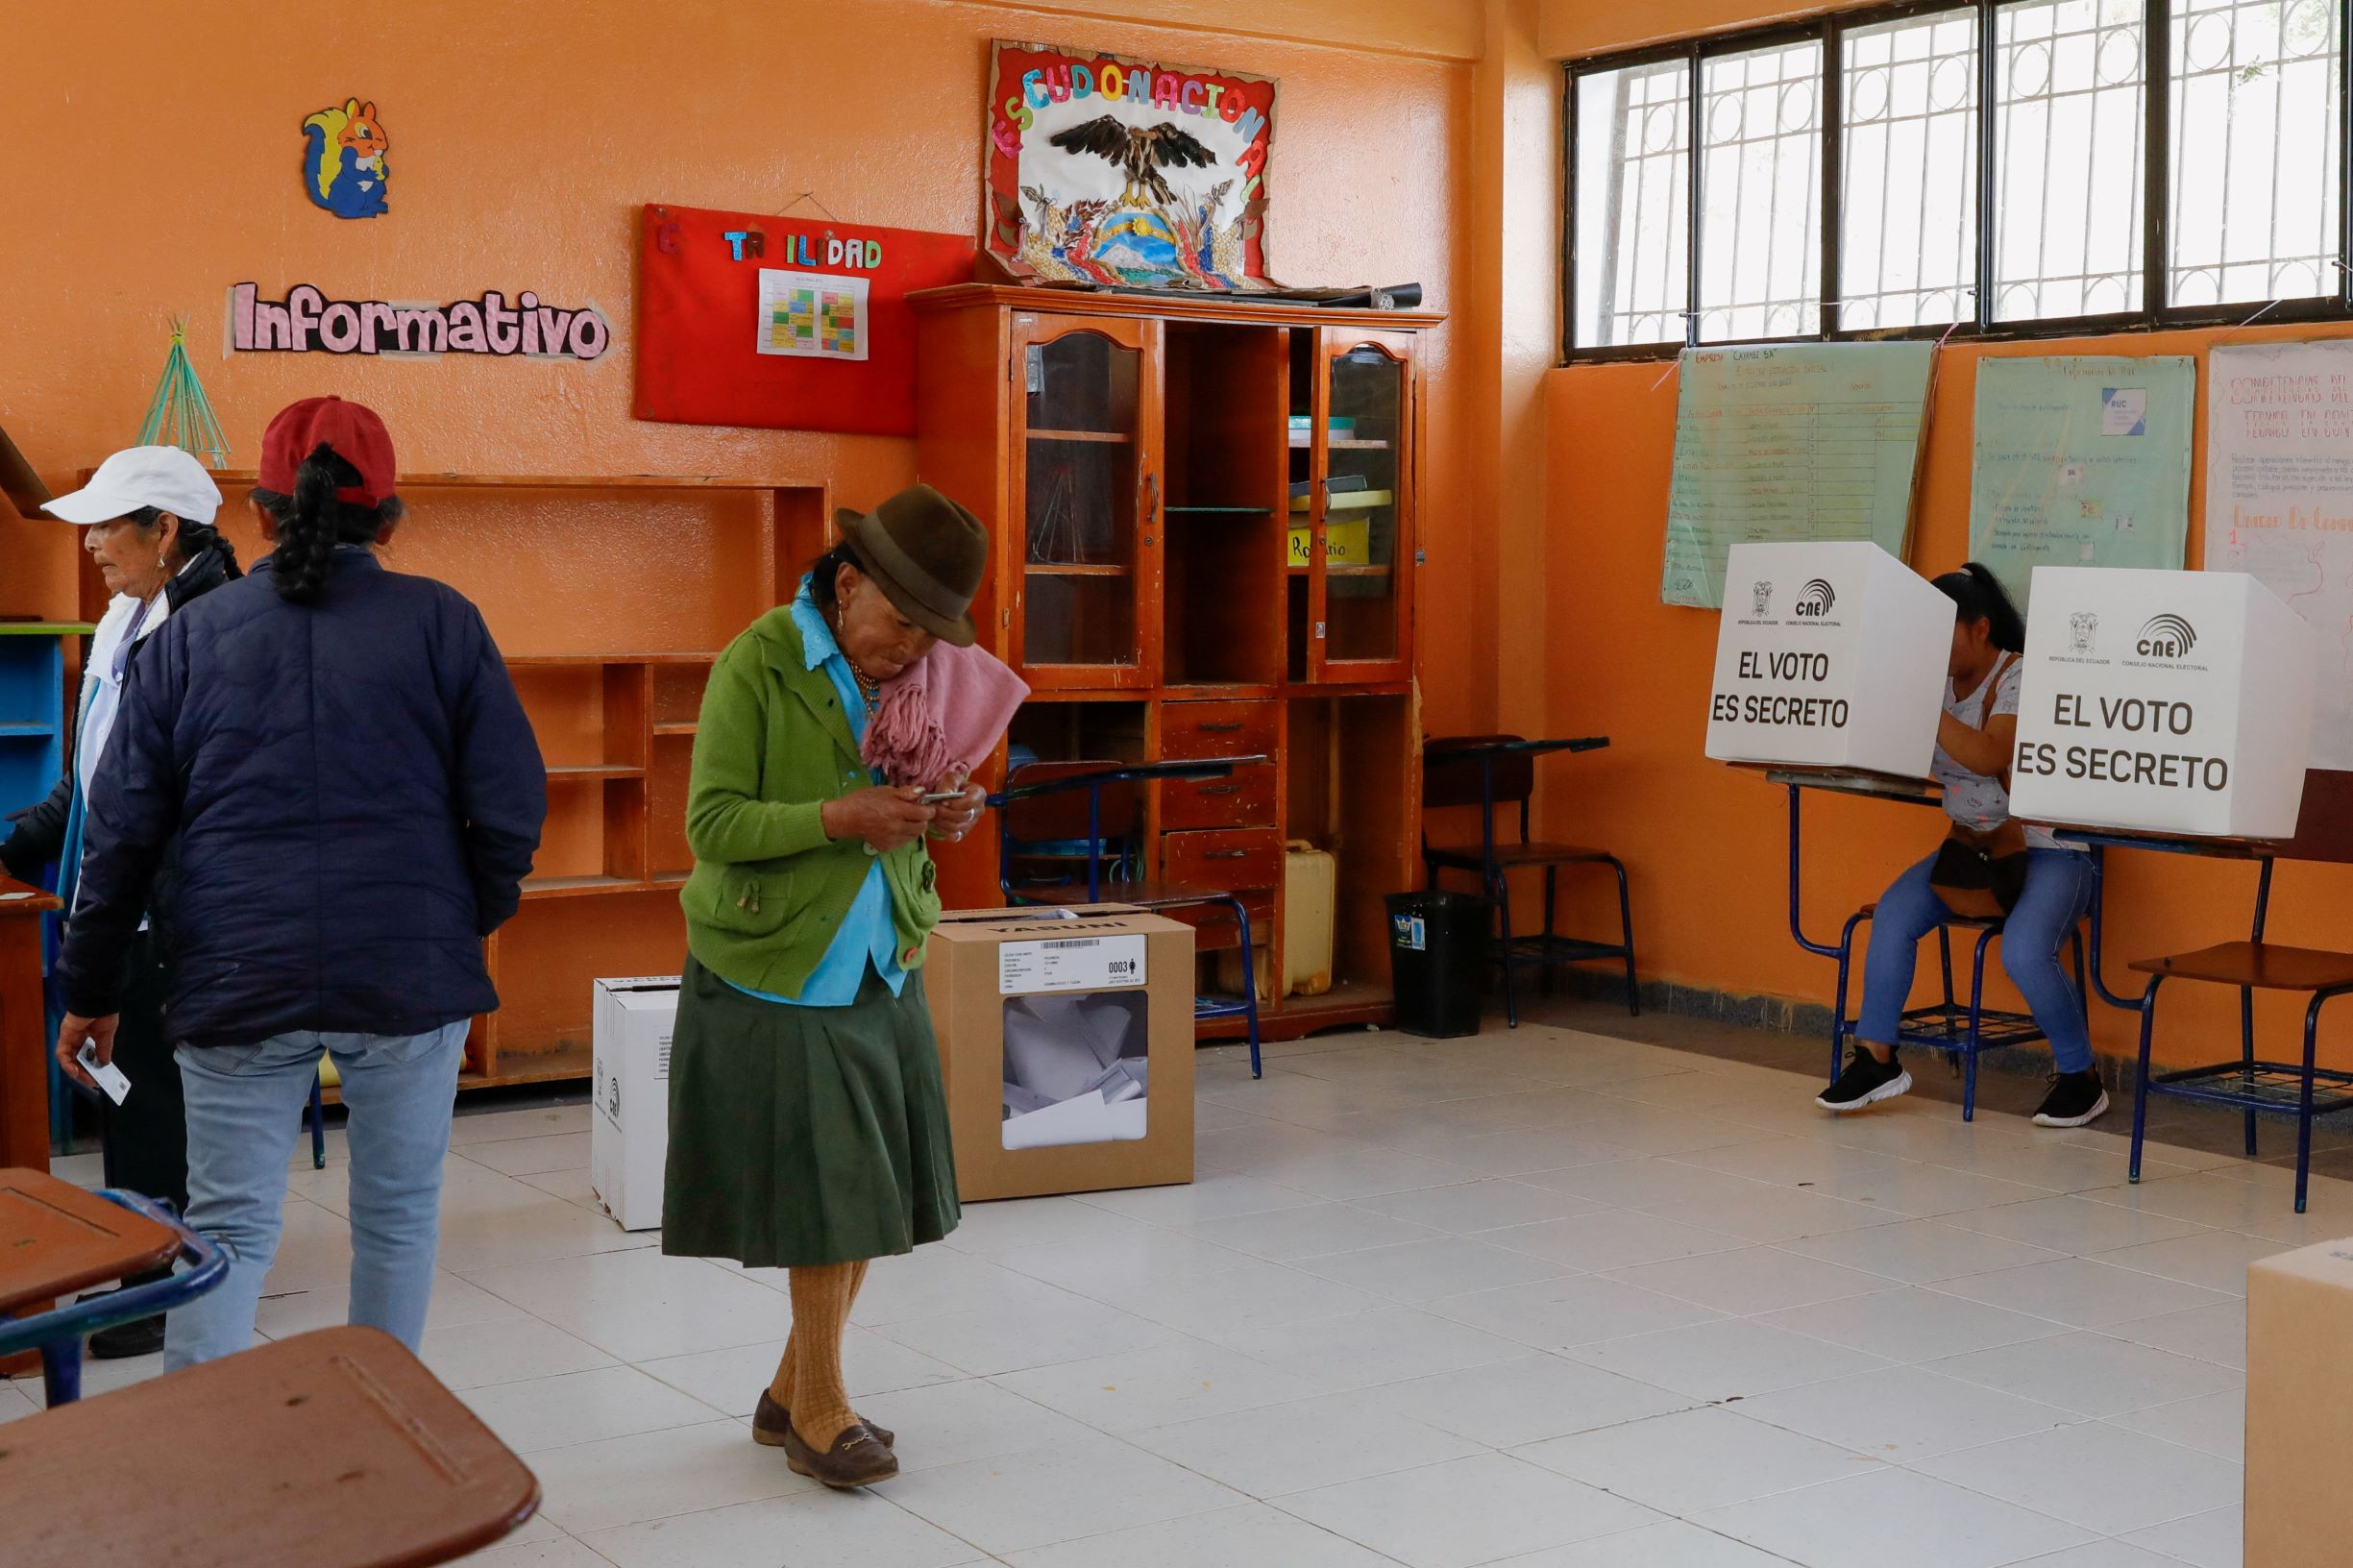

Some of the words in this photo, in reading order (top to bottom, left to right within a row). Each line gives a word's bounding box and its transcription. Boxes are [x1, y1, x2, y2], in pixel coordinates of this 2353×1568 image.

[234, 282, 607, 359] Informativo
[1292, 536, 1345, 557] Rorio
[1796, 601, 1822, 616] CNE
[2136, 639, 2175, 658] CNE
[1738, 651, 1763, 679] EL
[1769, 651, 1829, 682] VOTO
[1712, 694, 1738, 723] ES
[1744, 696, 1849, 728] SECRETO
[2053, 694, 2091, 727] EL
[2099, 697, 2194, 736] VOTO
[2017, 742, 2056, 775] ES
[2066, 746, 2228, 791] SECRETO
[1108, 961, 1128, 973] 0003
